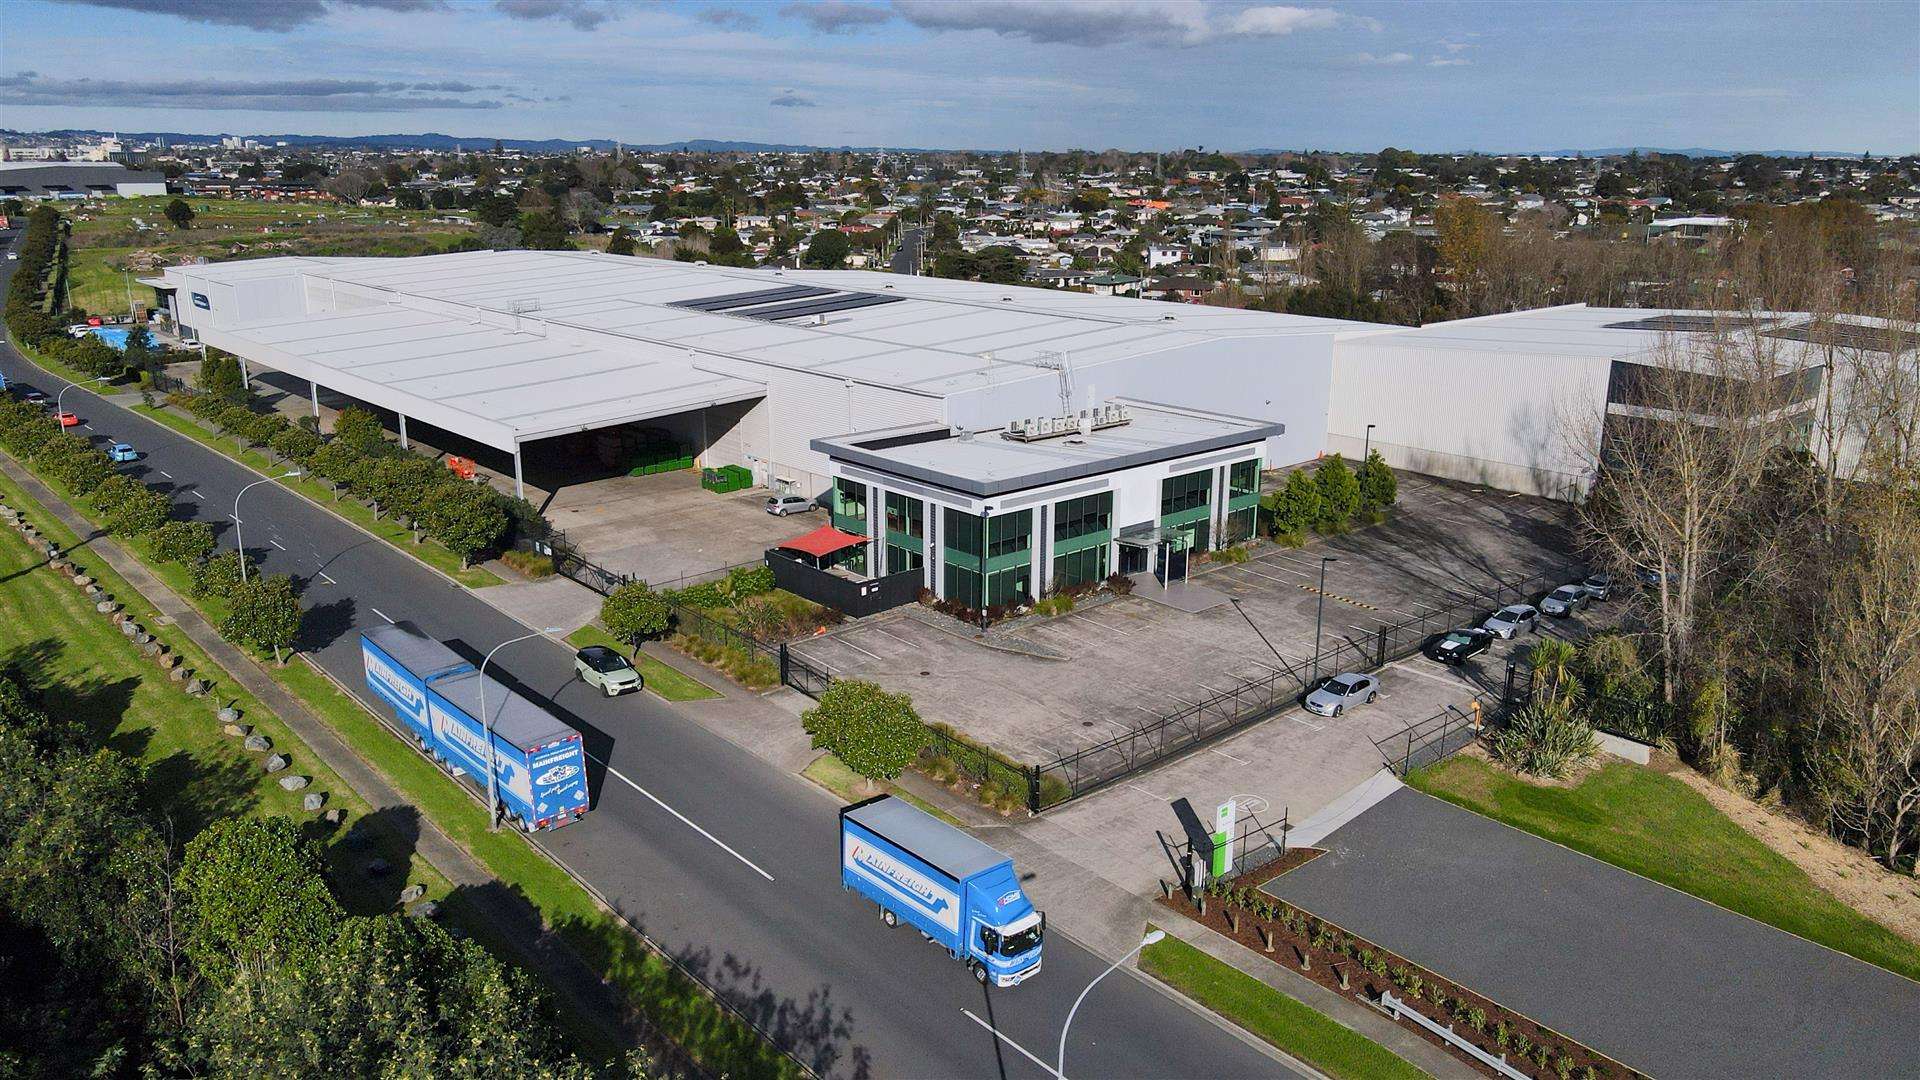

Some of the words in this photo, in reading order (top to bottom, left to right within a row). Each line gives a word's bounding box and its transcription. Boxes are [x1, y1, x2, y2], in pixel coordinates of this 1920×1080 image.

[366, 654, 421, 708] MAINFREIGHT
[441, 714, 511, 775] MAINFREHT
[532, 749, 579, 769] MAINFREIGHT
[853, 845, 942, 906] MAINFREIGHT
